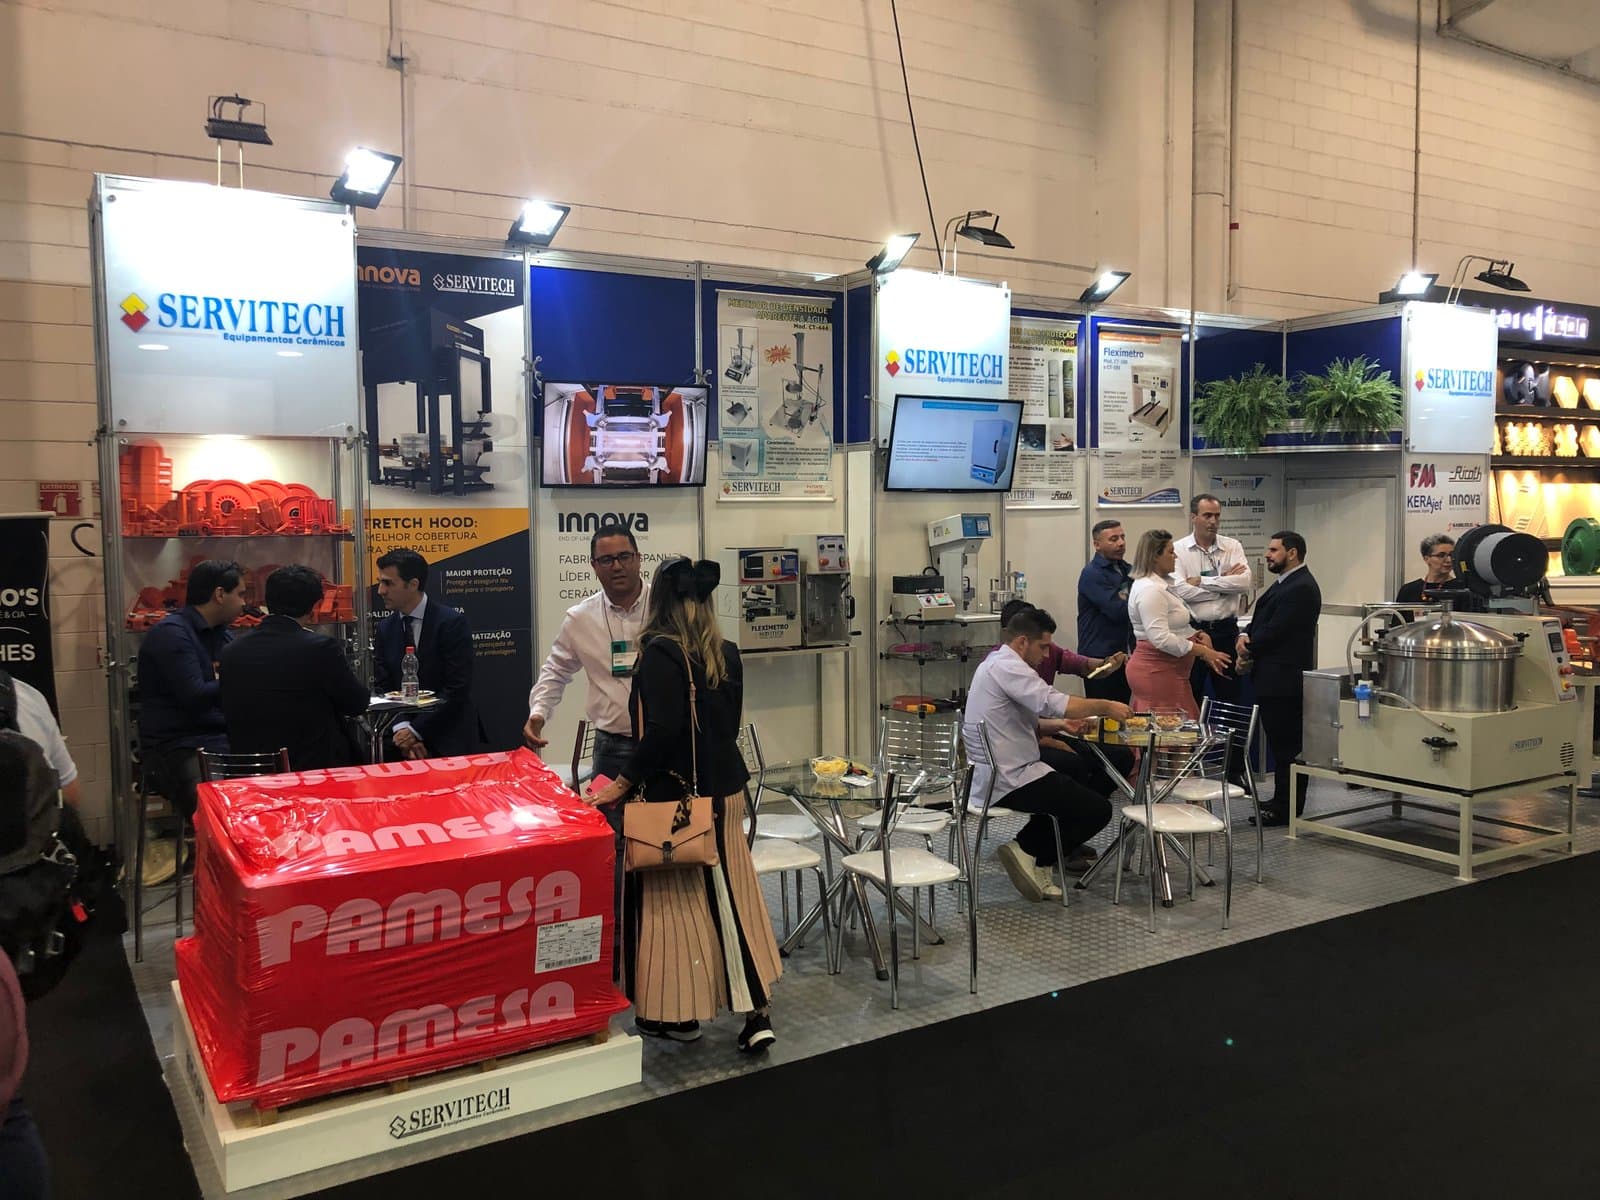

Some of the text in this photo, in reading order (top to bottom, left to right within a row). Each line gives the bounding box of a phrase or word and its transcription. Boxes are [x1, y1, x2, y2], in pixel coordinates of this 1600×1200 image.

[447, 274, 515, 293] SERVITECH
[158, 293, 346, 337] SERVITECH
[223, 333, 346, 347] Equipamentos Cerâmicos
[904, 348, 1003, 378] SERVITECH
[1427, 368, 1493, 392] SERVITECH
[1410, 463, 1436, 488] FM
[732, 482, 780, 492] SERVITECH
[1110, 487, 1143, 495] SERVITECH
[1407, 495, 1442, 514] KERAjet
[430, 517, 478, 528] HOOD:
[416, 531, 478, 541] COBERTURA
[446, 567, 512, 577] MAIOR PROTEÇÃO
[560, 571, 591, 581] LÍDER
[274, 804, 564, 860] PAMESA
[256, 869, 581, 968] PAMESA
[256, 981, 576, 1087] PAMESA
[410, 1087, 510, 1130] SERVITECH
